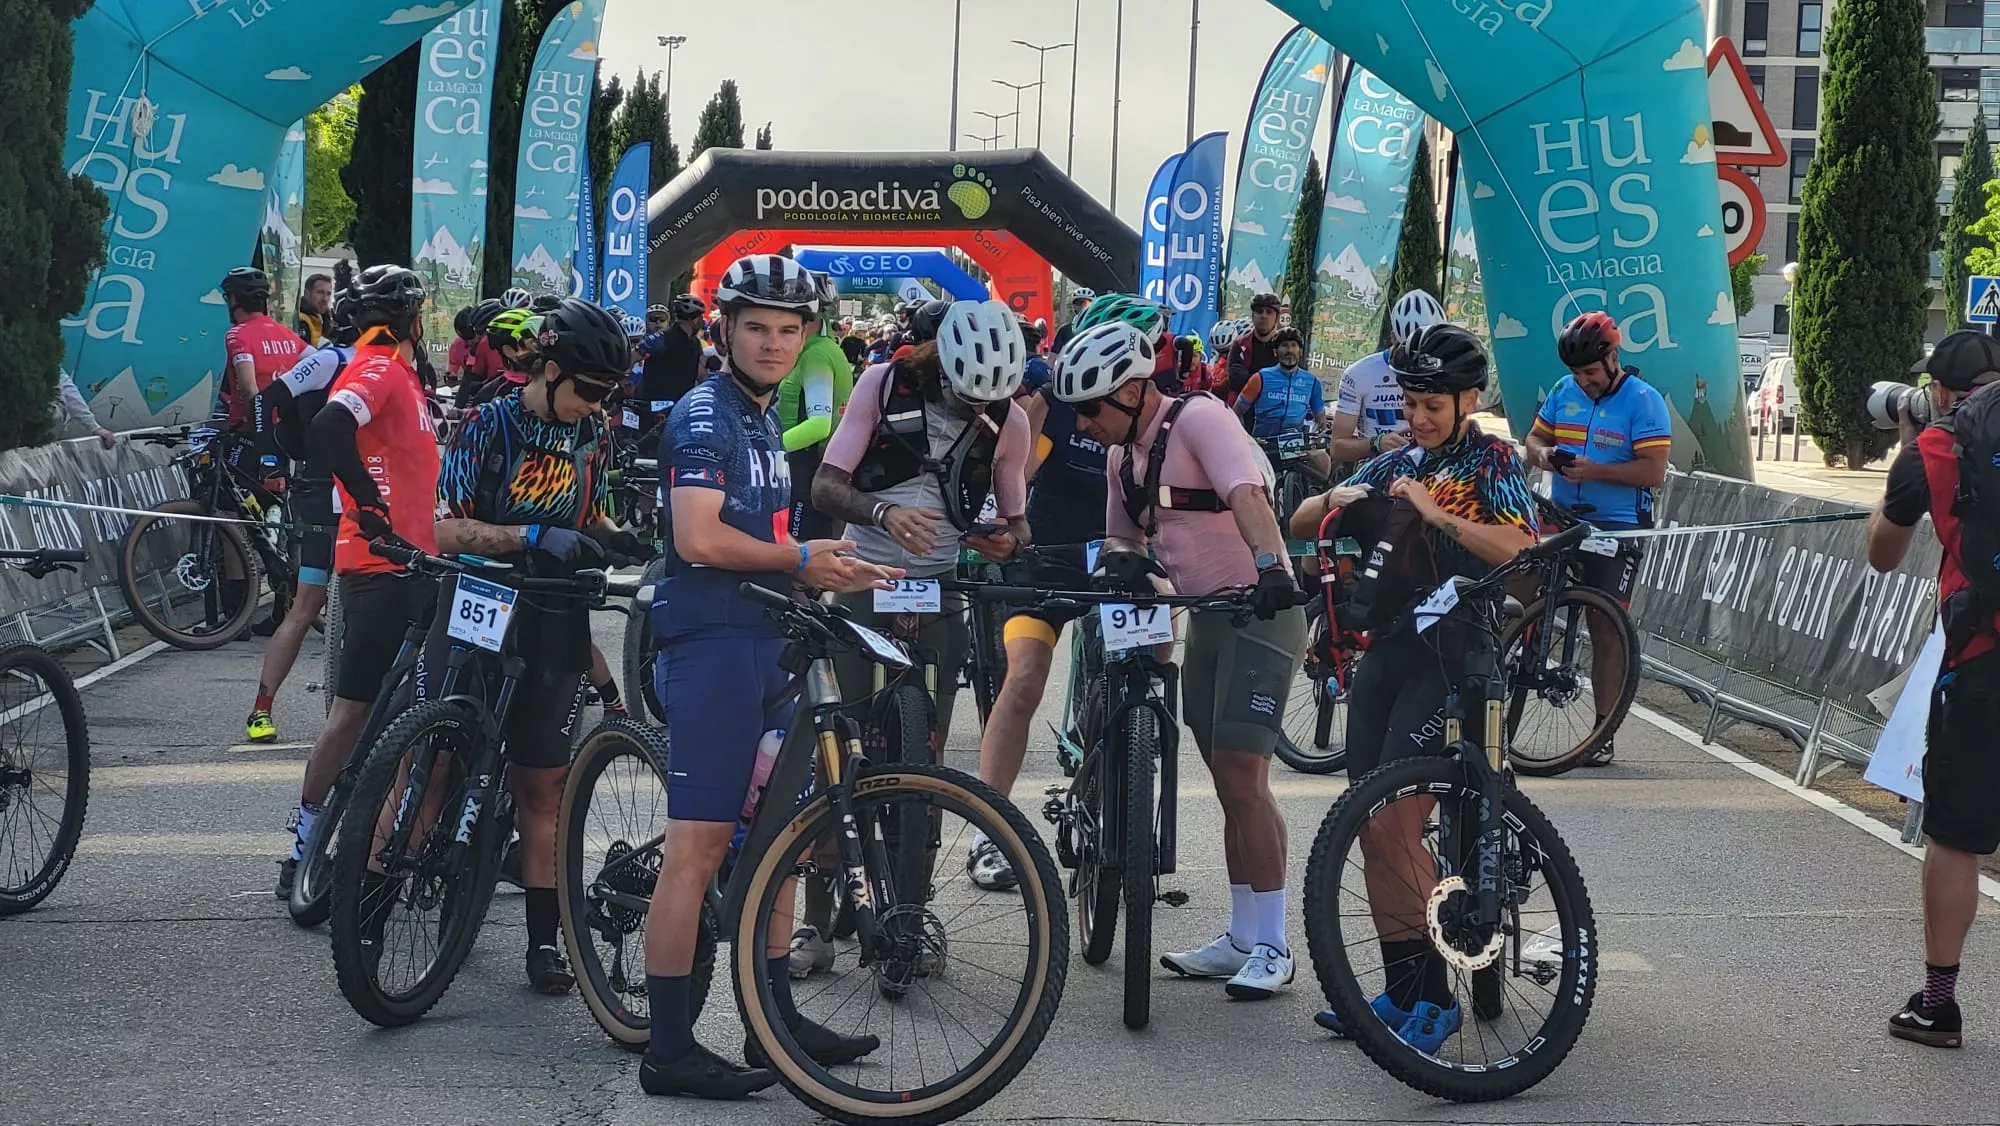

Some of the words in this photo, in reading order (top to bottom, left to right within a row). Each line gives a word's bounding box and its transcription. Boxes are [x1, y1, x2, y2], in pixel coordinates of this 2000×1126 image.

[429, 38, 486, 79] es
[427, 80, 443, 92] La
[534, 70, 585, 96] Hu
[425, 96, 484, 135] ca
[531, 95, 582, 129] es
[1265, 88, 1313, 118] Hu
[1353, 98, 1370, 111] La
[528, 127, 542, 138] La
[1258, 112, 1308, 149] es
[1346, 115, 1411, 161] ca
[1529, 112, 1652, 176] Hu
[526, 141, 577, 173] ca
[1249, 158, 1297, 193] ca
[651, 230, 677, 249] bien,
[674, 212, 695, 230] vive
[695, 187, 721, 214] mejor
[757, 181, 940, 219] podoactiva
[784, 211, 848, 221] PODOLOGÍA
[853, 213, 859, 221] Y
[862, 211, 941, 222] BIOMECÁNICA
[1212, 184, 1221, 252] PROFESIONAL
[1537, 173, 1660, 253] es
[639, 189, 647, 250] PROFESIONAL
[1020, 186, 1041, 209] Pisa
[1040, 204, 1063, 228] bien,
[1064, 223, 1084, 241] vive
[1084, 238, 1113, 264] mejor
[606, 187, 637, 302] GEO
[859, 254, 913, 271] GEO
[1168, 181, 1208, 311] GEO
[1546, 263, 1573, 284] La
[252, 393, 264, 433] GARMIN
[1767, 545, 1850, 641] GOBIK
[460, 599, 498, 629] 851
[1111, 605, 1159, 629] 917
[456, 796, 482, 843] FOX
[1573, 926, 1589, 1007] MAXXIS
